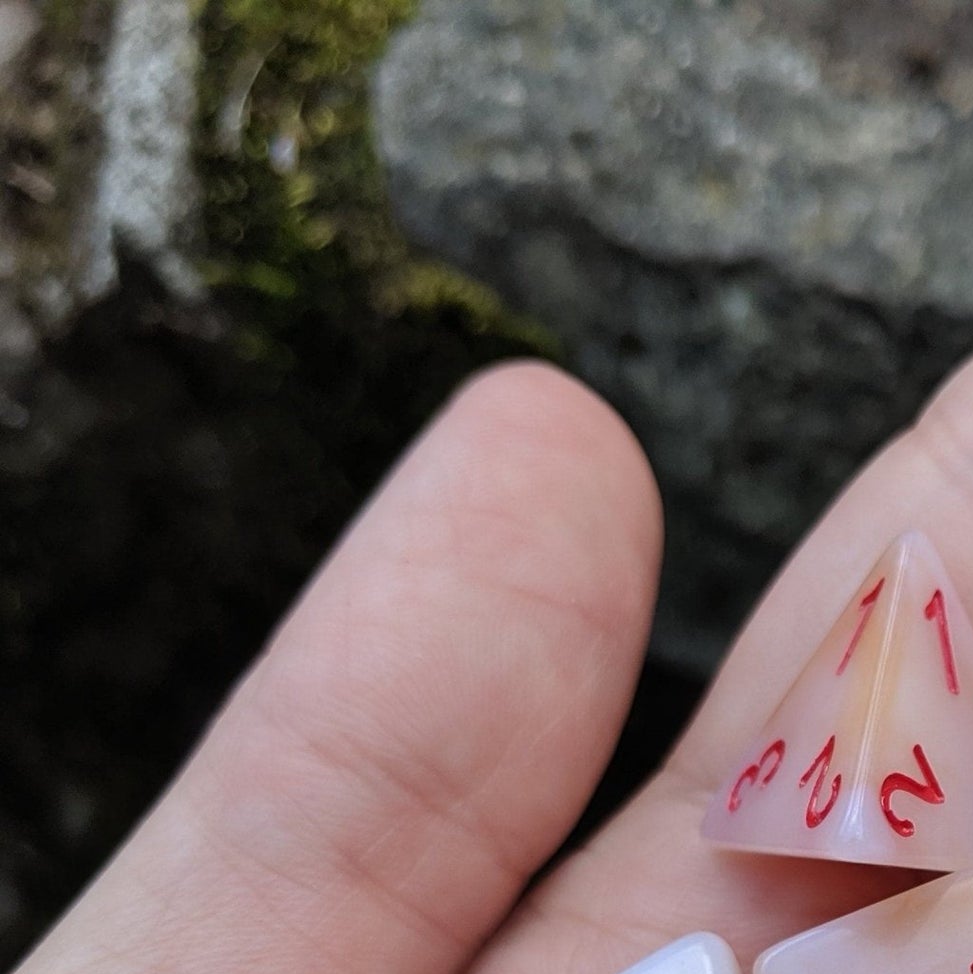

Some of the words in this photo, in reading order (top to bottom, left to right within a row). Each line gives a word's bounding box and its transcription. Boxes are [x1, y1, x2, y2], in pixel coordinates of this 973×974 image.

[838, 577, 885, 676] 1
[923, 588, 960, 695] 1
[727, 738, 786, 813] 3
[799, 734, 842, 829] 2
[880, 743, 945, 838] 2
